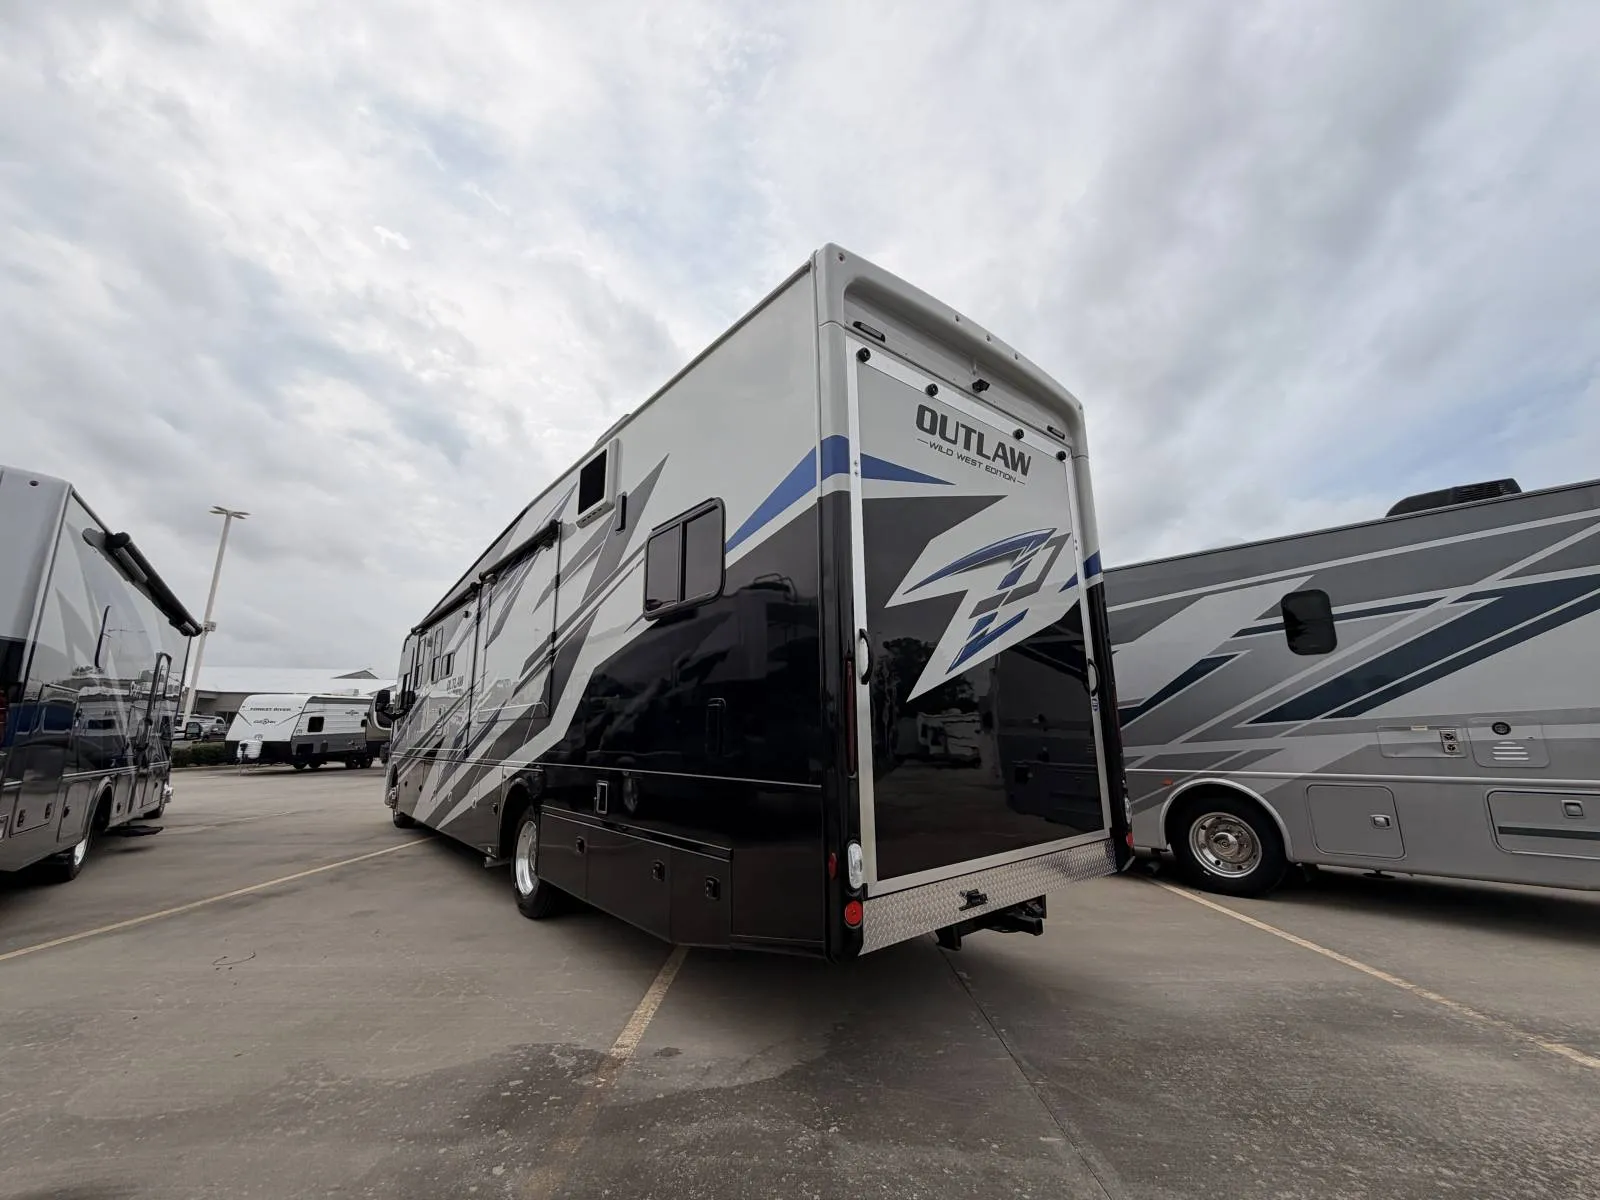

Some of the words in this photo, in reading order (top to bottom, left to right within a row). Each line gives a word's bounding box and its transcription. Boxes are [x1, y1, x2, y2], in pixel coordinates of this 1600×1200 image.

[915, 403, 1031, 477] OUTLAW
[929, 440, 954, 457] WILD
[956, 451, 983, 469] WEST
[985, 464, 1016, 484] EDITION
